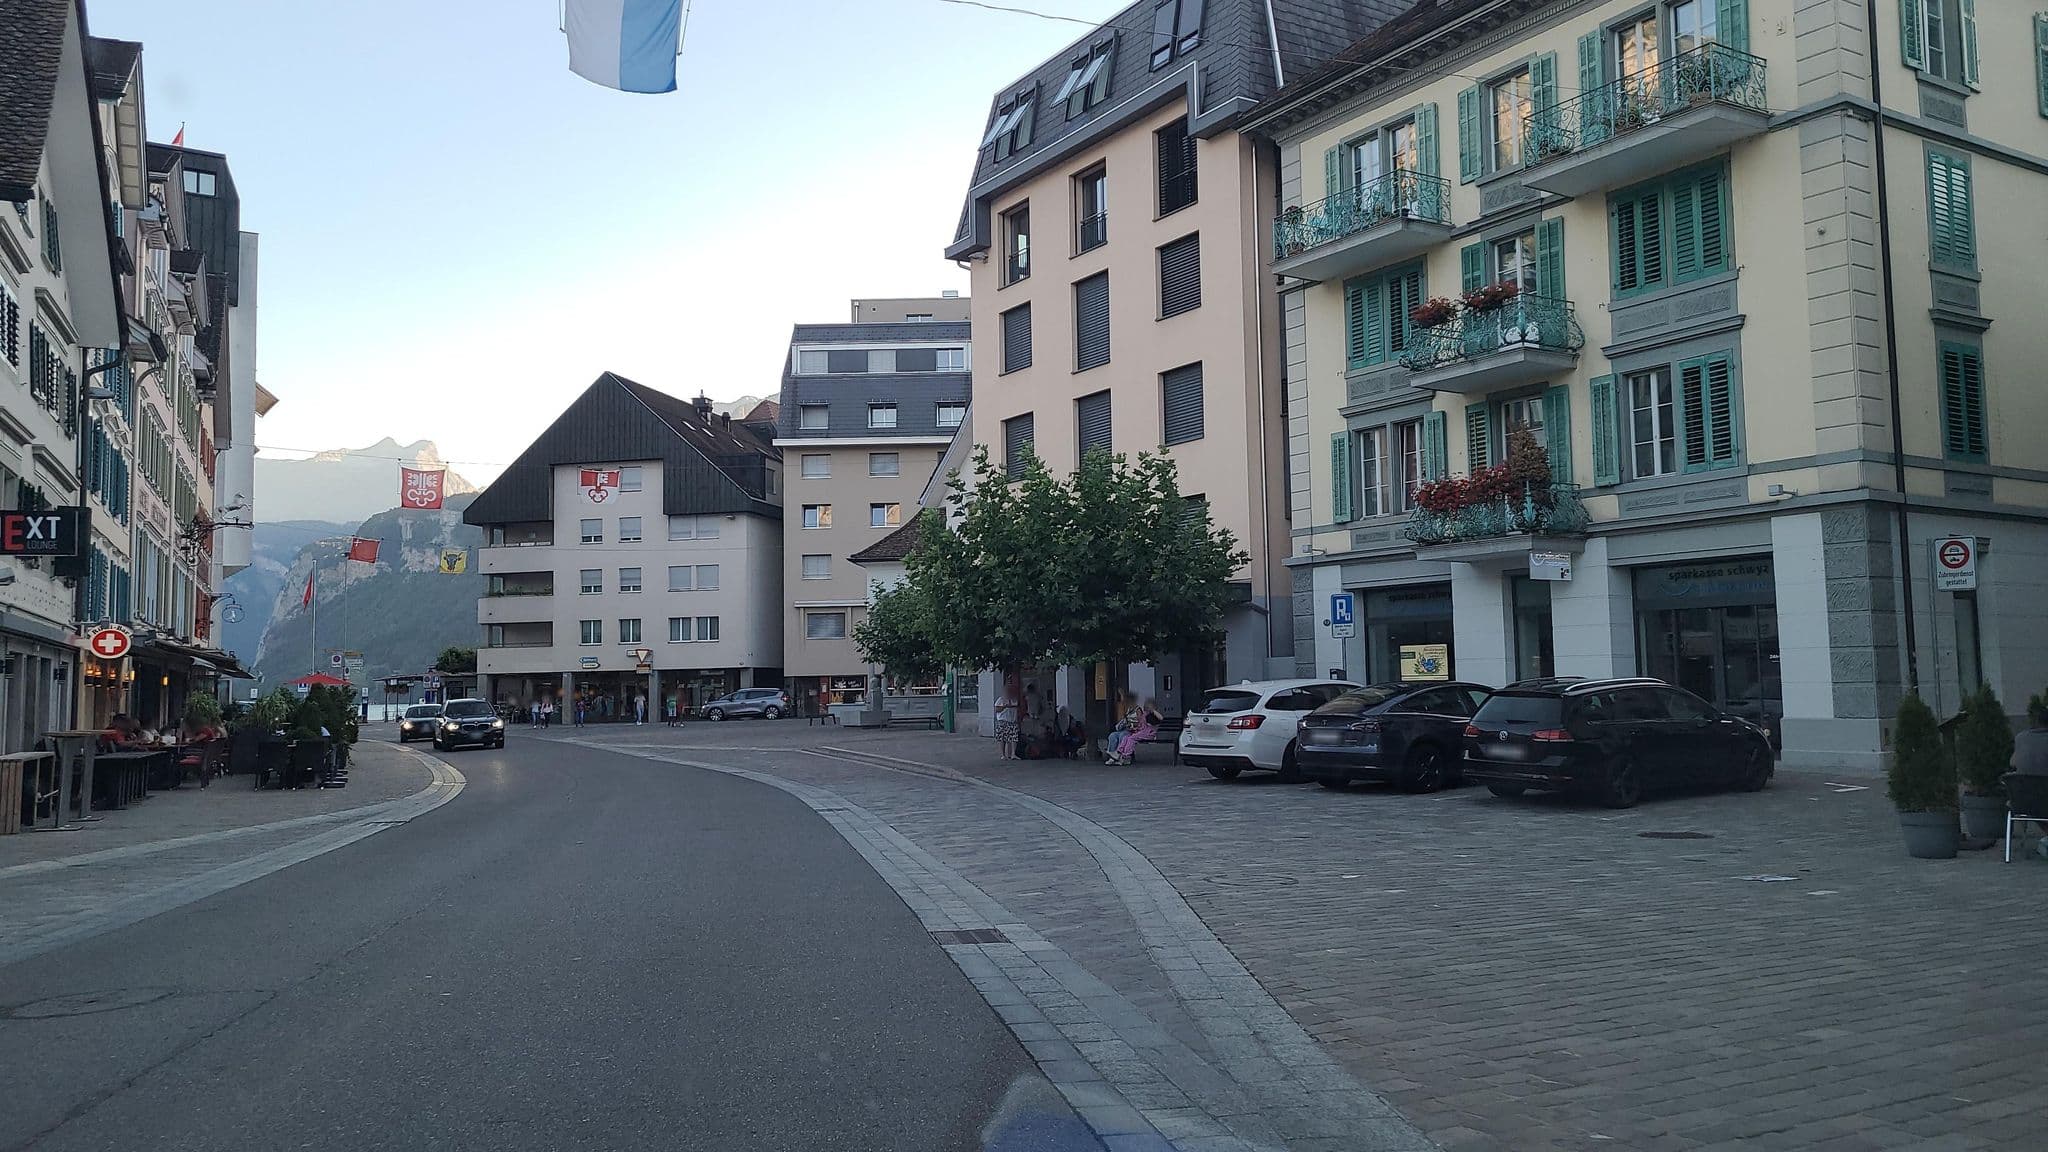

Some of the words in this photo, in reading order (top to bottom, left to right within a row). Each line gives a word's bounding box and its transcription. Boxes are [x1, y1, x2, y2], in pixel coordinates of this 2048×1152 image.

[0, 515, 61, 550] EXT
[27, 541, 58, 550] LOUNGE
[1669, 568, 1723, 581] sparkasse
[1727, 564, 1769, 577] schwyz
[1946, 579, 1967, 587] gestattet
